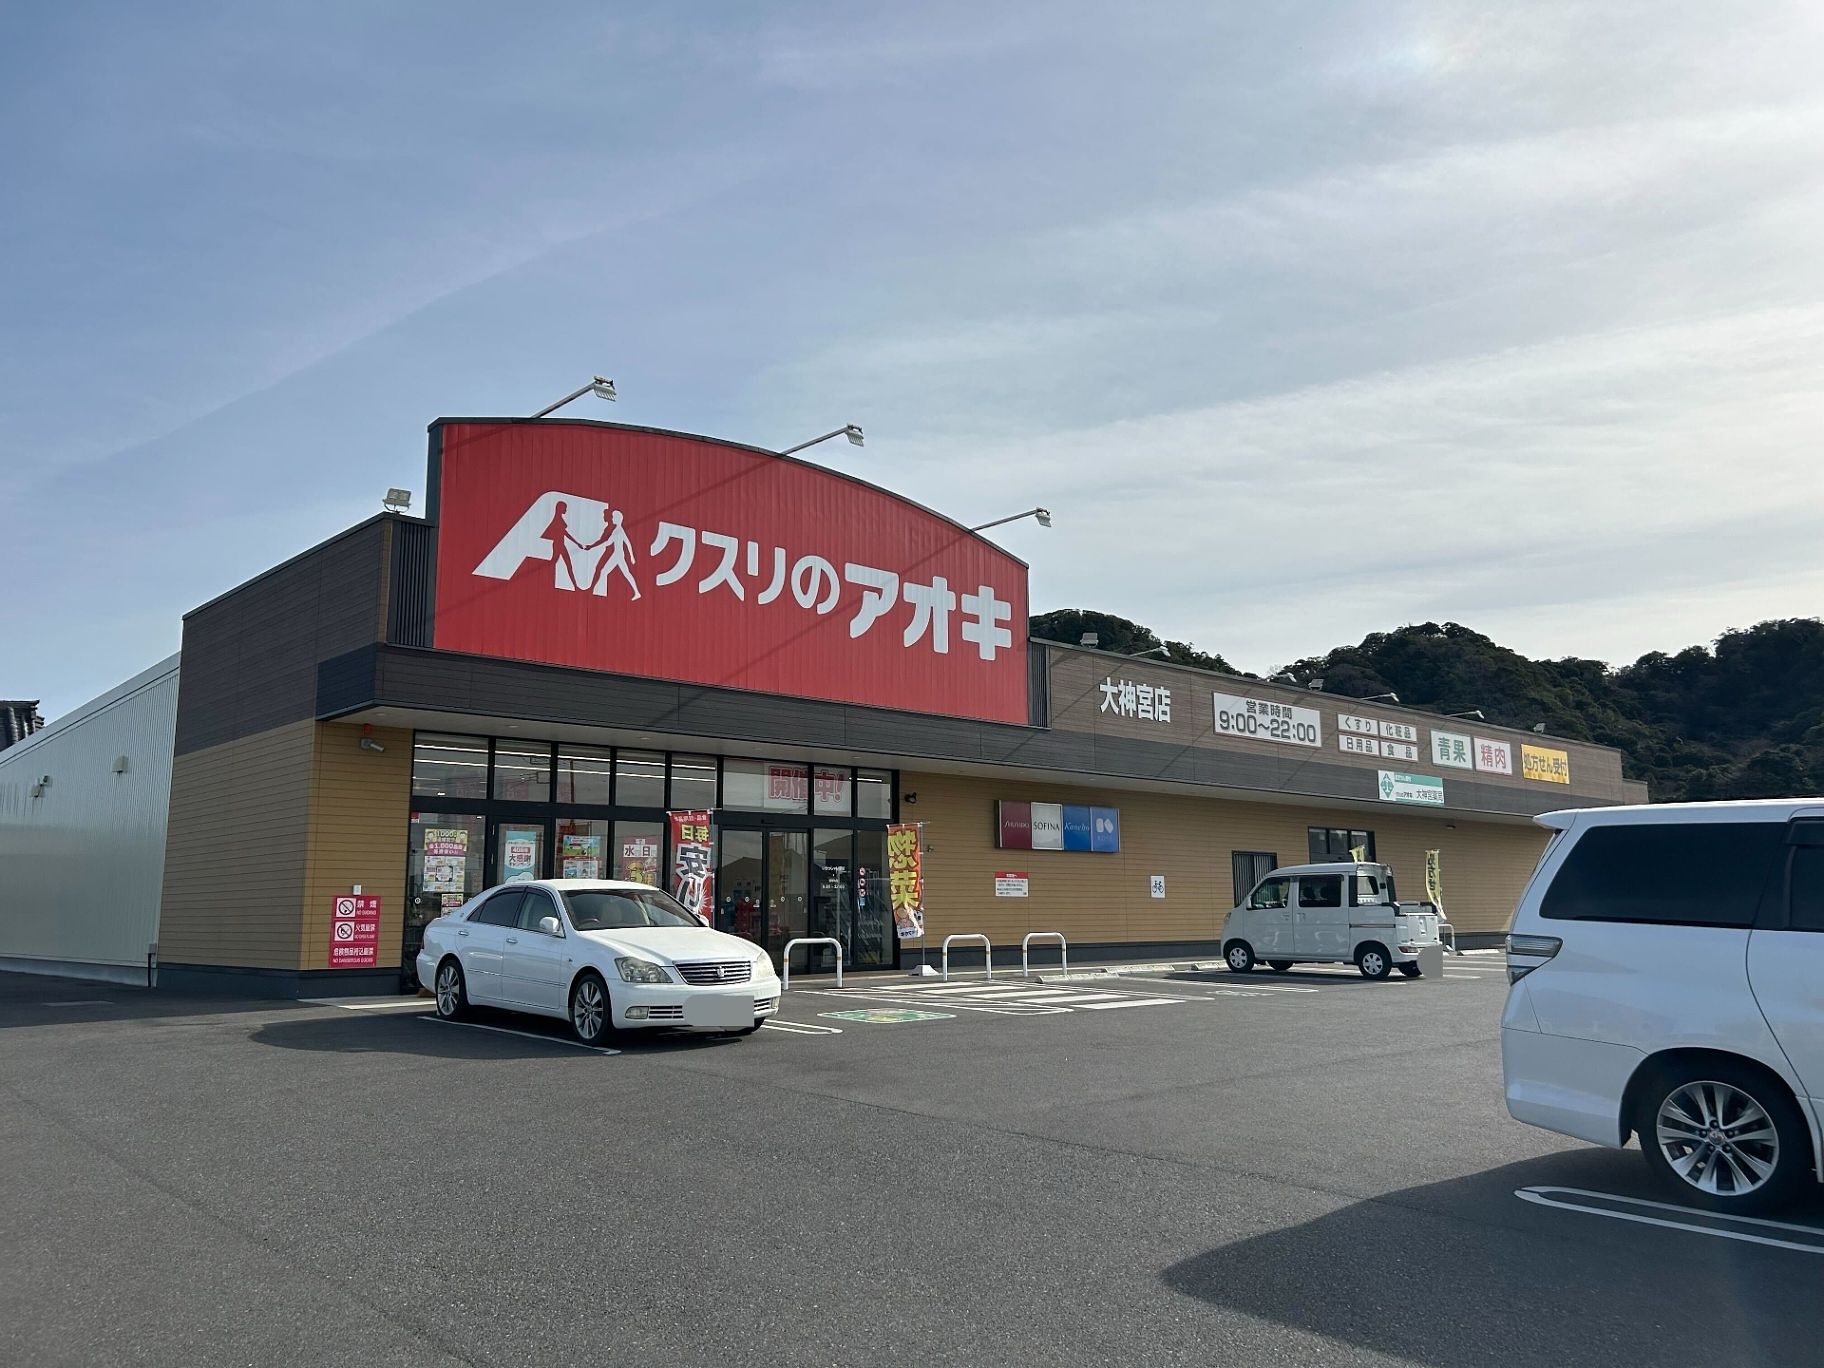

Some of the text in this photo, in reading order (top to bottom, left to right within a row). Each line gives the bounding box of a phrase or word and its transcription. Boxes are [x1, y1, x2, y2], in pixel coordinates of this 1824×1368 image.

[651, 521, 1012, 661] クスリのアオキ
[1099, 677, 1171, 723] 大神宮店
[1246, 701, 1293, 720] 営業時間
[1345, 717, 1371, 732] くすり
[1386, 724, 1411, 739] 化粧品
[1346, 737, 1373, 753] 日用品
[1438, 737, 1466, 762] 青果
[1480, 744, 1507, 769] 精肉
[1523, 753, 1567, 777] 処方せん受付
[1033, 821, 1060, 831] SOFINA
[1064, 822, 1090, 832] Kanebo
[509, 854, 532, 863] 大感謝
[357, 900, 377, 908] 禁煙
